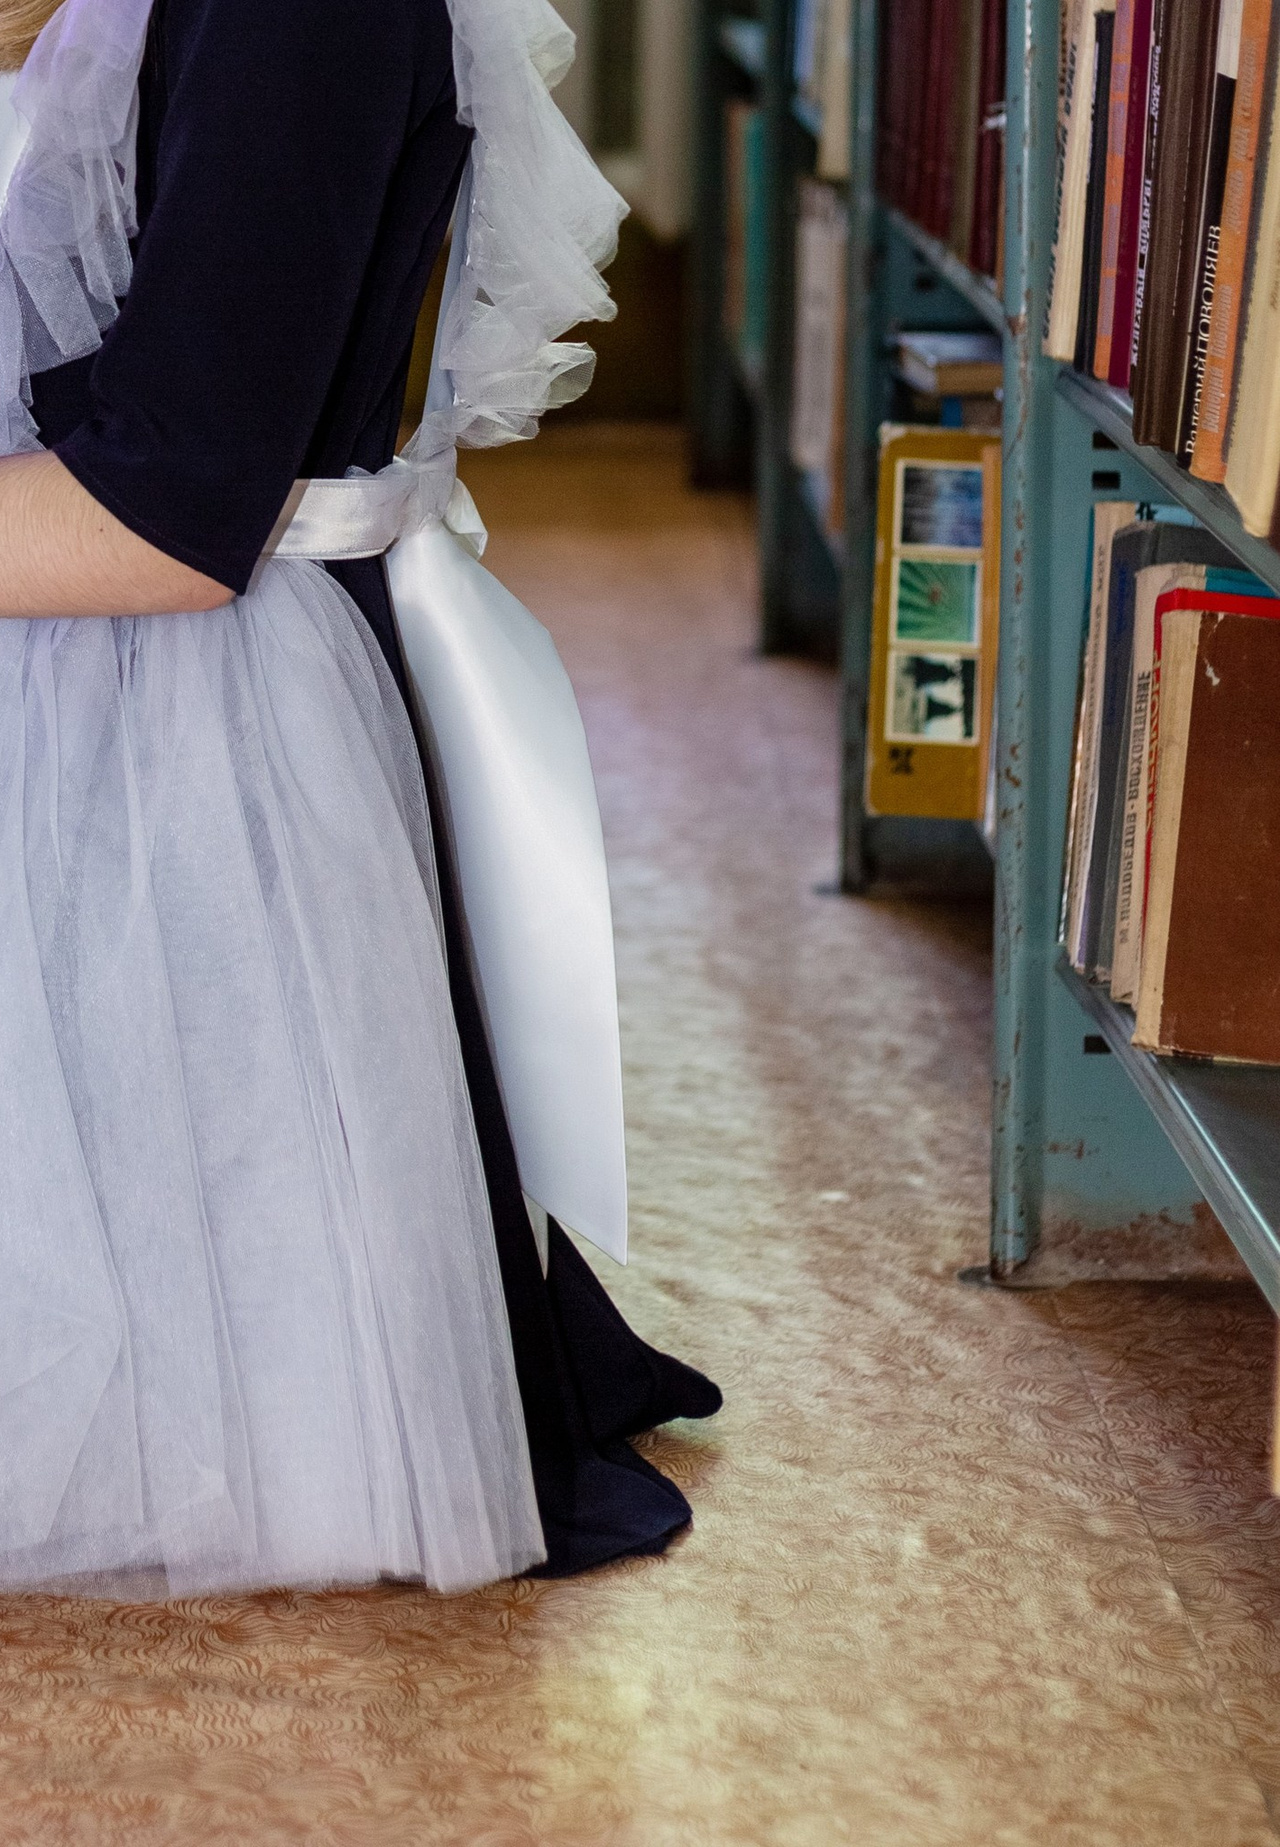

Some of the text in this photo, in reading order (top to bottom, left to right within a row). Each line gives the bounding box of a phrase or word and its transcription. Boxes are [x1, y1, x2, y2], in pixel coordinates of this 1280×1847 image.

[1185, 225, 1221, 453] Валерий ПОВОЛЯЕВ
[1128, 671, 1151, 801] ВОСХОЖДЕНИЕ
